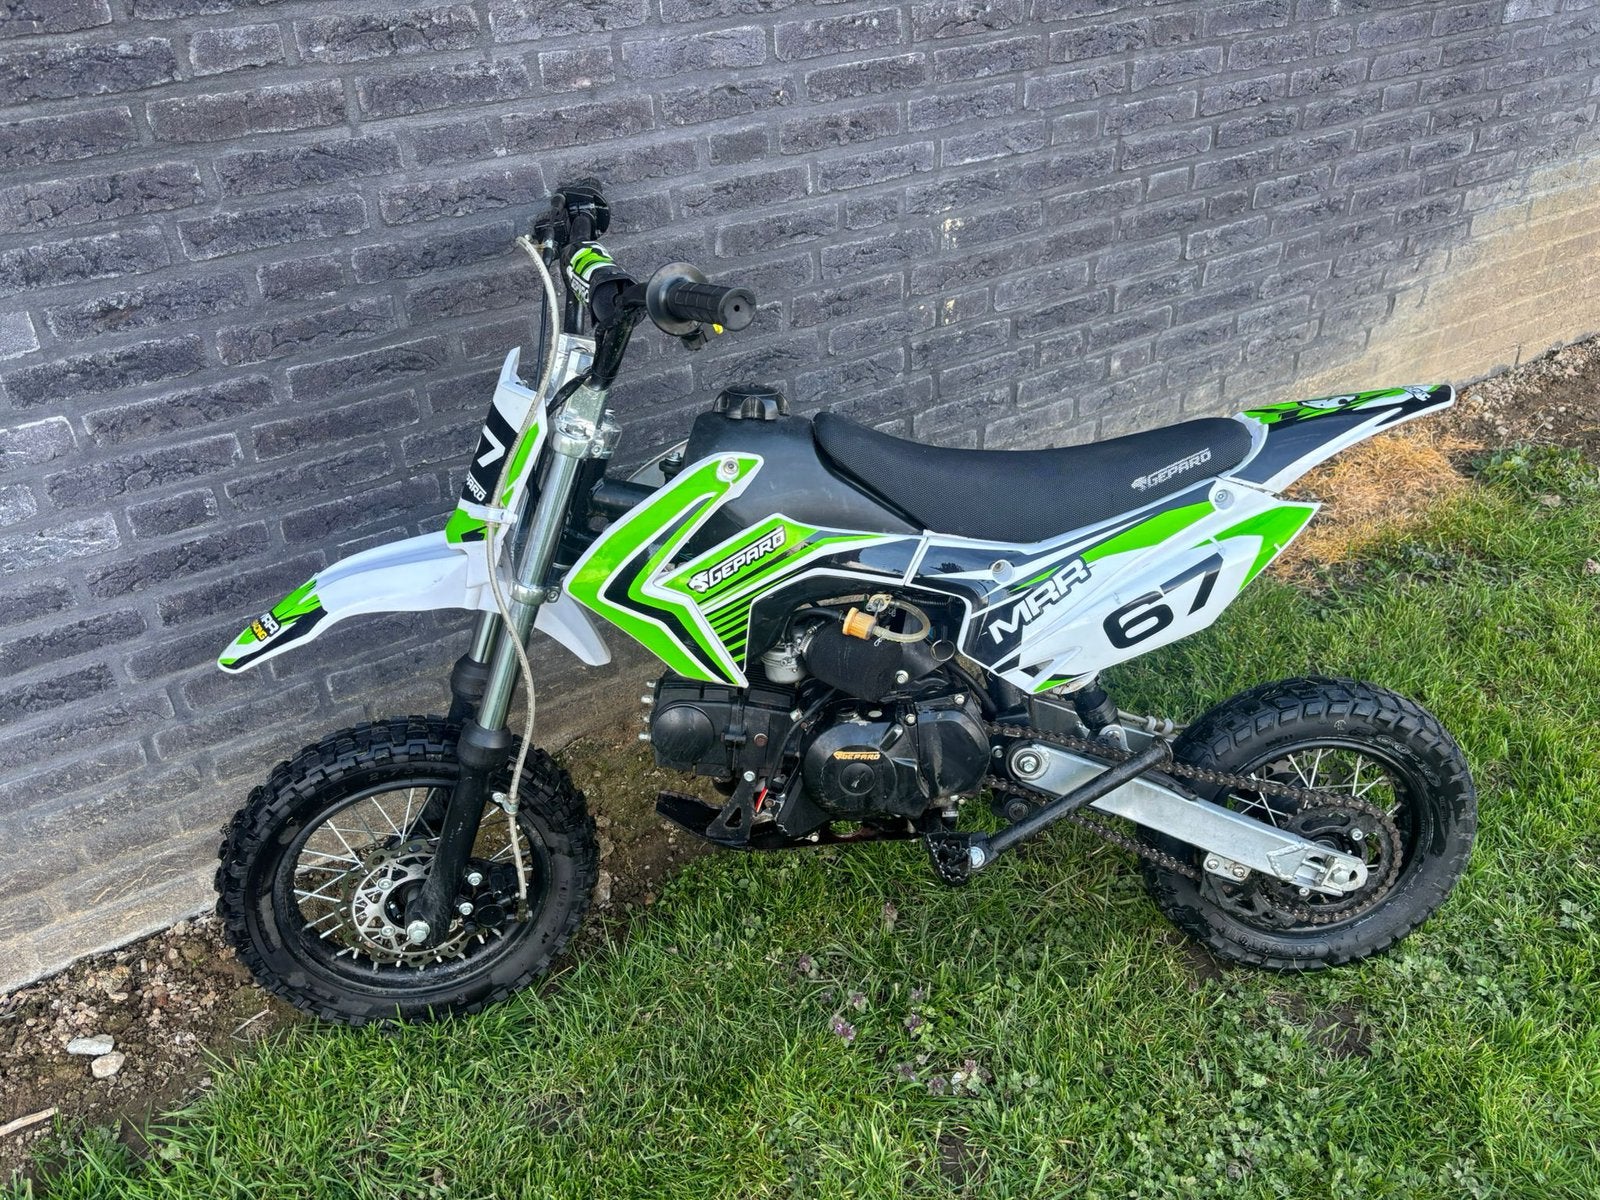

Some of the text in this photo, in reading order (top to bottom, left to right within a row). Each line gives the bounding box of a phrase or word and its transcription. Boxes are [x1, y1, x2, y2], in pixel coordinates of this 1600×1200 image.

[1146, 447, 1212, 489] GEPARD
[708, 525, 786, 587] GEPARD
[987, 557, 1090, 645] MRR
[1102, 551, 1224, 650] 67
[842, 751, 881, 760] GEPARD
